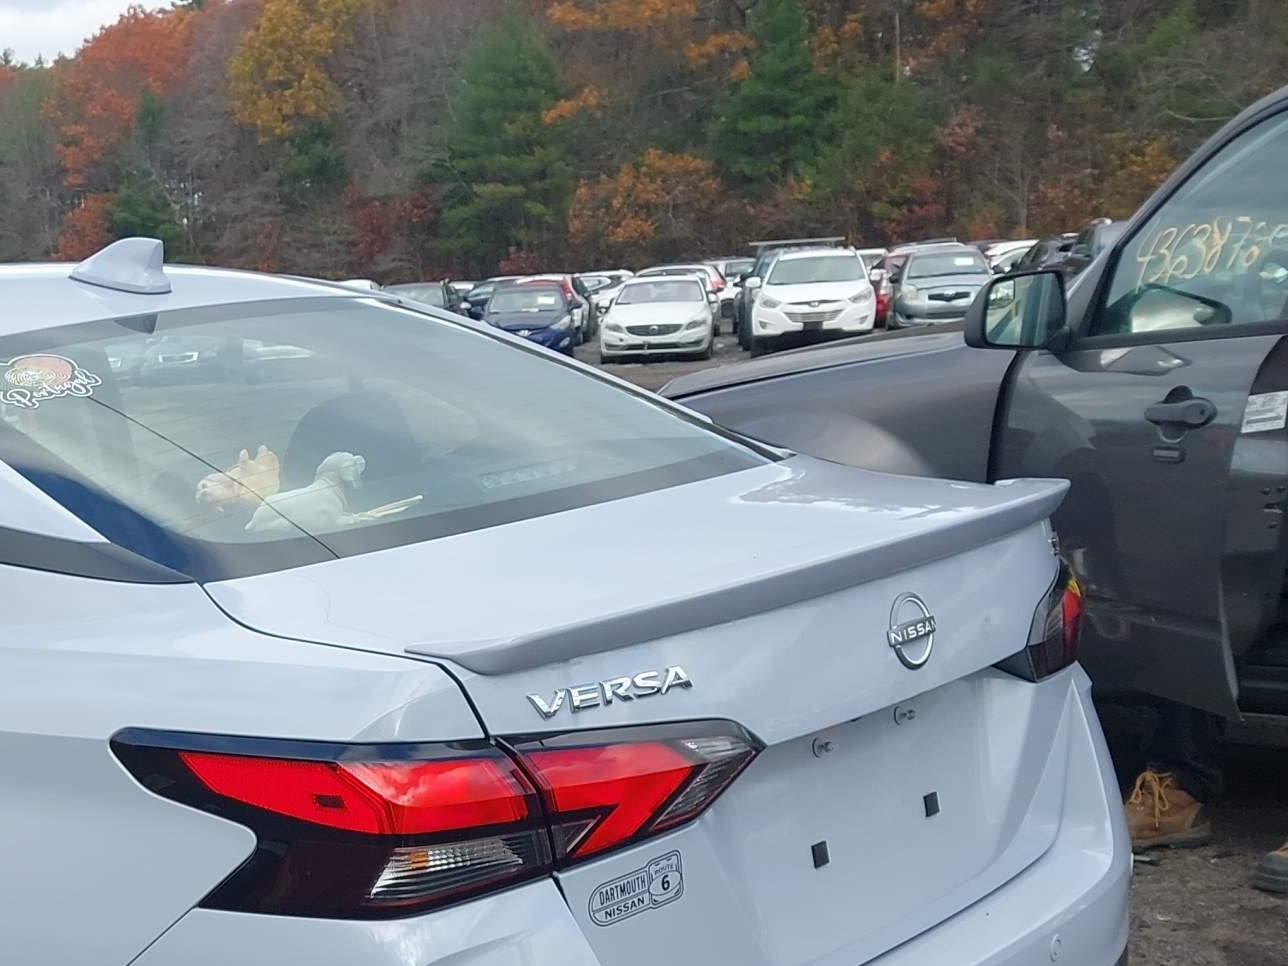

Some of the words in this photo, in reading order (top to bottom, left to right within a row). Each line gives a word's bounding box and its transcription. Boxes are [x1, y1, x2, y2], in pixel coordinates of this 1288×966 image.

[6, 368, 96, 408] Portugal
[890, 619, 936, 644] NISSAN
[526, 665, 693, 720] VERSA
[654, 863, 674, 876] ROUTE
[598, 874, 647, 906] DARTMOUTH
[661, 874, 671, 891] 6
[604, 896, 645, 920] NISSAN
